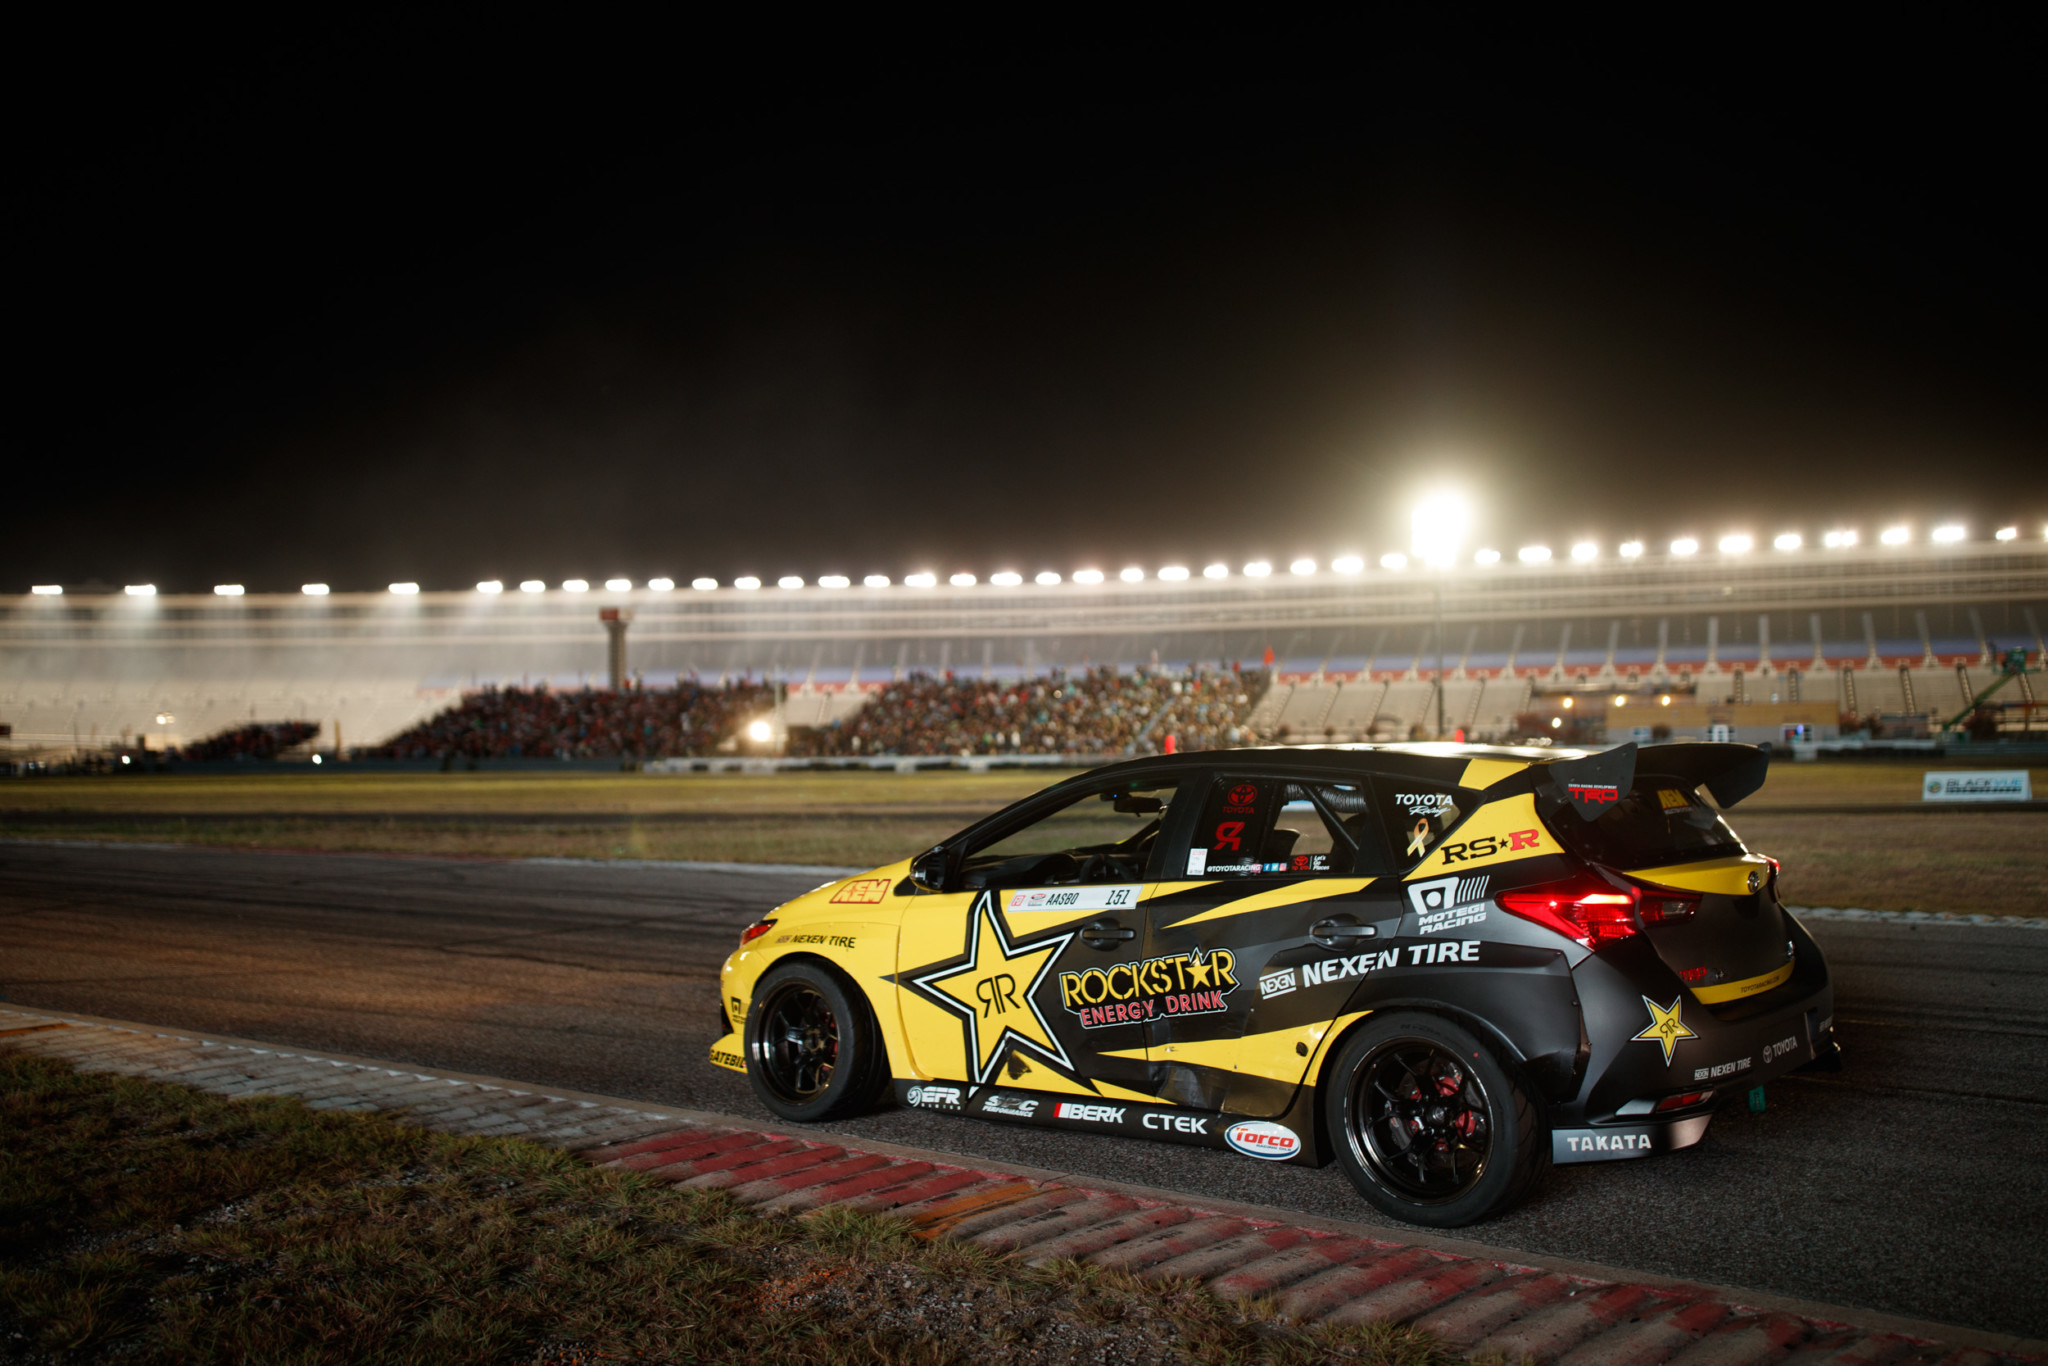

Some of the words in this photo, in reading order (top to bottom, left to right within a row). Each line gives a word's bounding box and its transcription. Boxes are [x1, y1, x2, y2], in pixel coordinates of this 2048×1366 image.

[1395, 794, 1454, 806] TOYOTA
[1568, 787, 1618, 804] TRD
[1223, 806, 1255, 814] TOYOTA
[1418, 902, 1486, 926] MOTEGI
[1419, 912, 1487, 935] RACING
[790, 934, 828, 945] NEXEN
[829, 935, 857, 949] TIRE
[1302, 948, 1400, 988] NEXEN
[1408, 940, 1481, 966] TIRE
[1080, 999, 1155, 1026] ENERGY
[1166, 990, 1225, 1014] DRINK
[1772, 1035, 1798, 1057] TOYOTA
[1710, 1061, 1736, 1078] NEXEN
[1736, 1056, 1752, 1071] TIRE
[921, 1086, 961, 1105] EFR
[1069, 1103, 1127, 1123] BERK
[1142, 1112, 1208, 1135] CTEK
[1235, 1127, 1295, 1148] Torco
[1566, 1134, 1652, 1152] TAKATA
